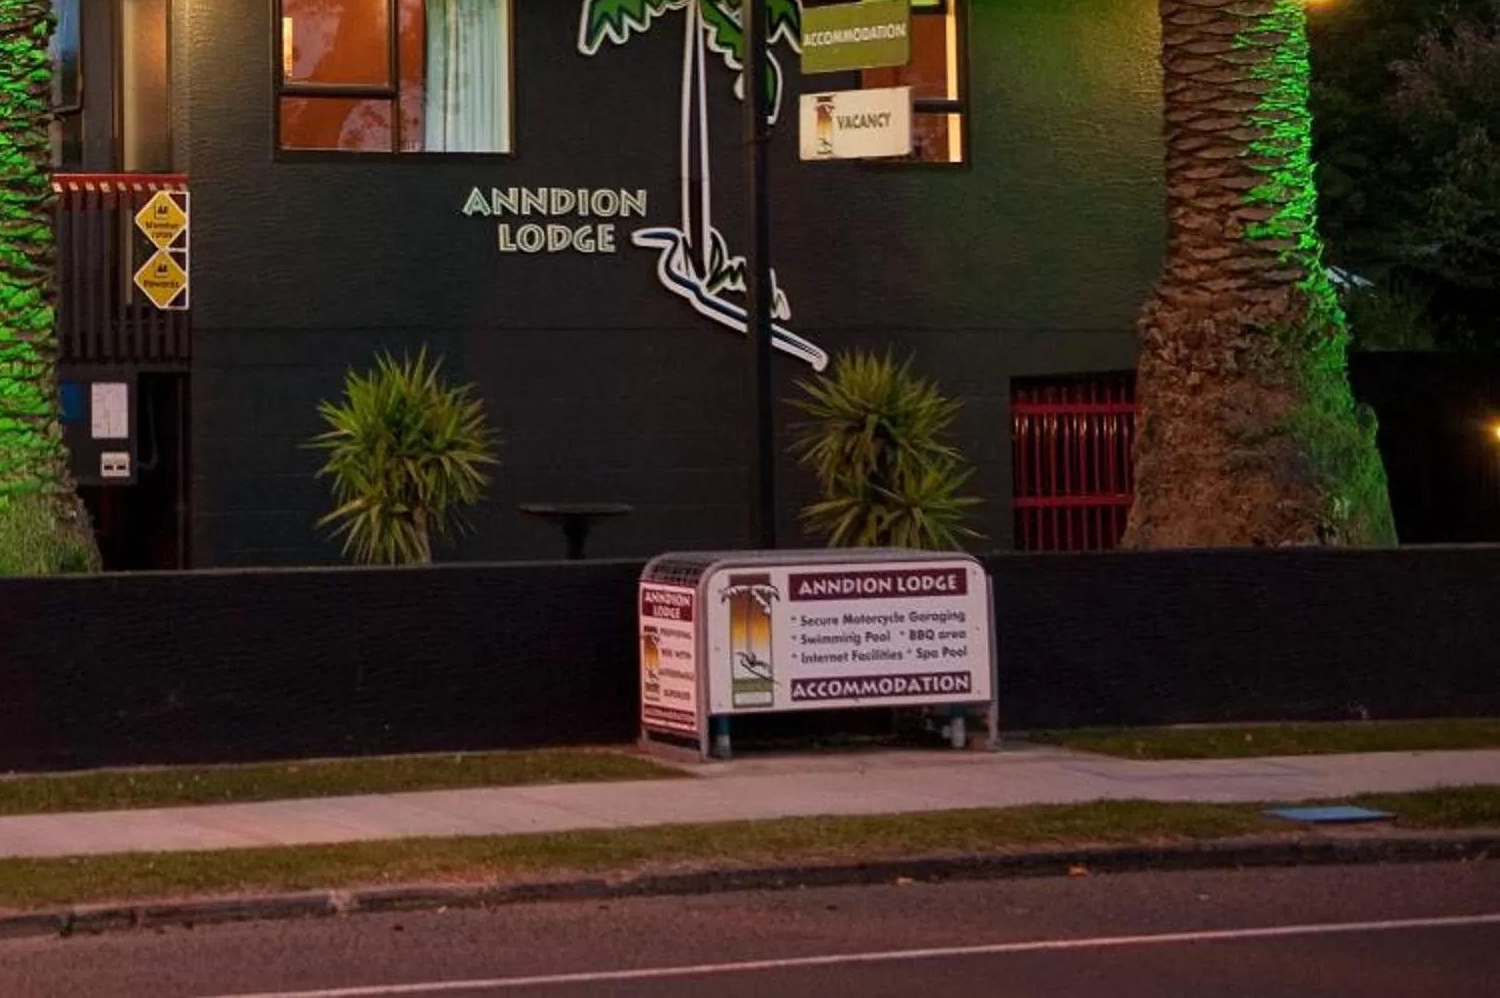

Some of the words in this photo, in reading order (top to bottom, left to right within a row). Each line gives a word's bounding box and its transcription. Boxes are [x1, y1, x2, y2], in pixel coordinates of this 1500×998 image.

[803, 23, 907, 47] ACCOMMODATION
[836, 110, 892, 131] VACANCY
[462, 186, 648, 217] ANNDION
[498, 223, 616, 253] LODGE
[799, 577, 892, 596] ANNDION
[897, 574, 957, 592] LODGE
[801, 615, 839, 627] Secure
[842, 612, 905, 626] Motorcycle
[908, 610, 966, 624] Garaging
[801, 632, 862, 645] Swimming
[865, 630, 891, 643] Pool
[909, 628, 935, 641] BBQ
[938, 629, 967, 640] area
[801, 652, 848, 664] Internet
[851, 650, 903, 662] Facilities
[916, 648, 939, 661] Spa
[942, 646, 967, 658] Pool
[792, 676, 969, 698] ACCOMMODATION
